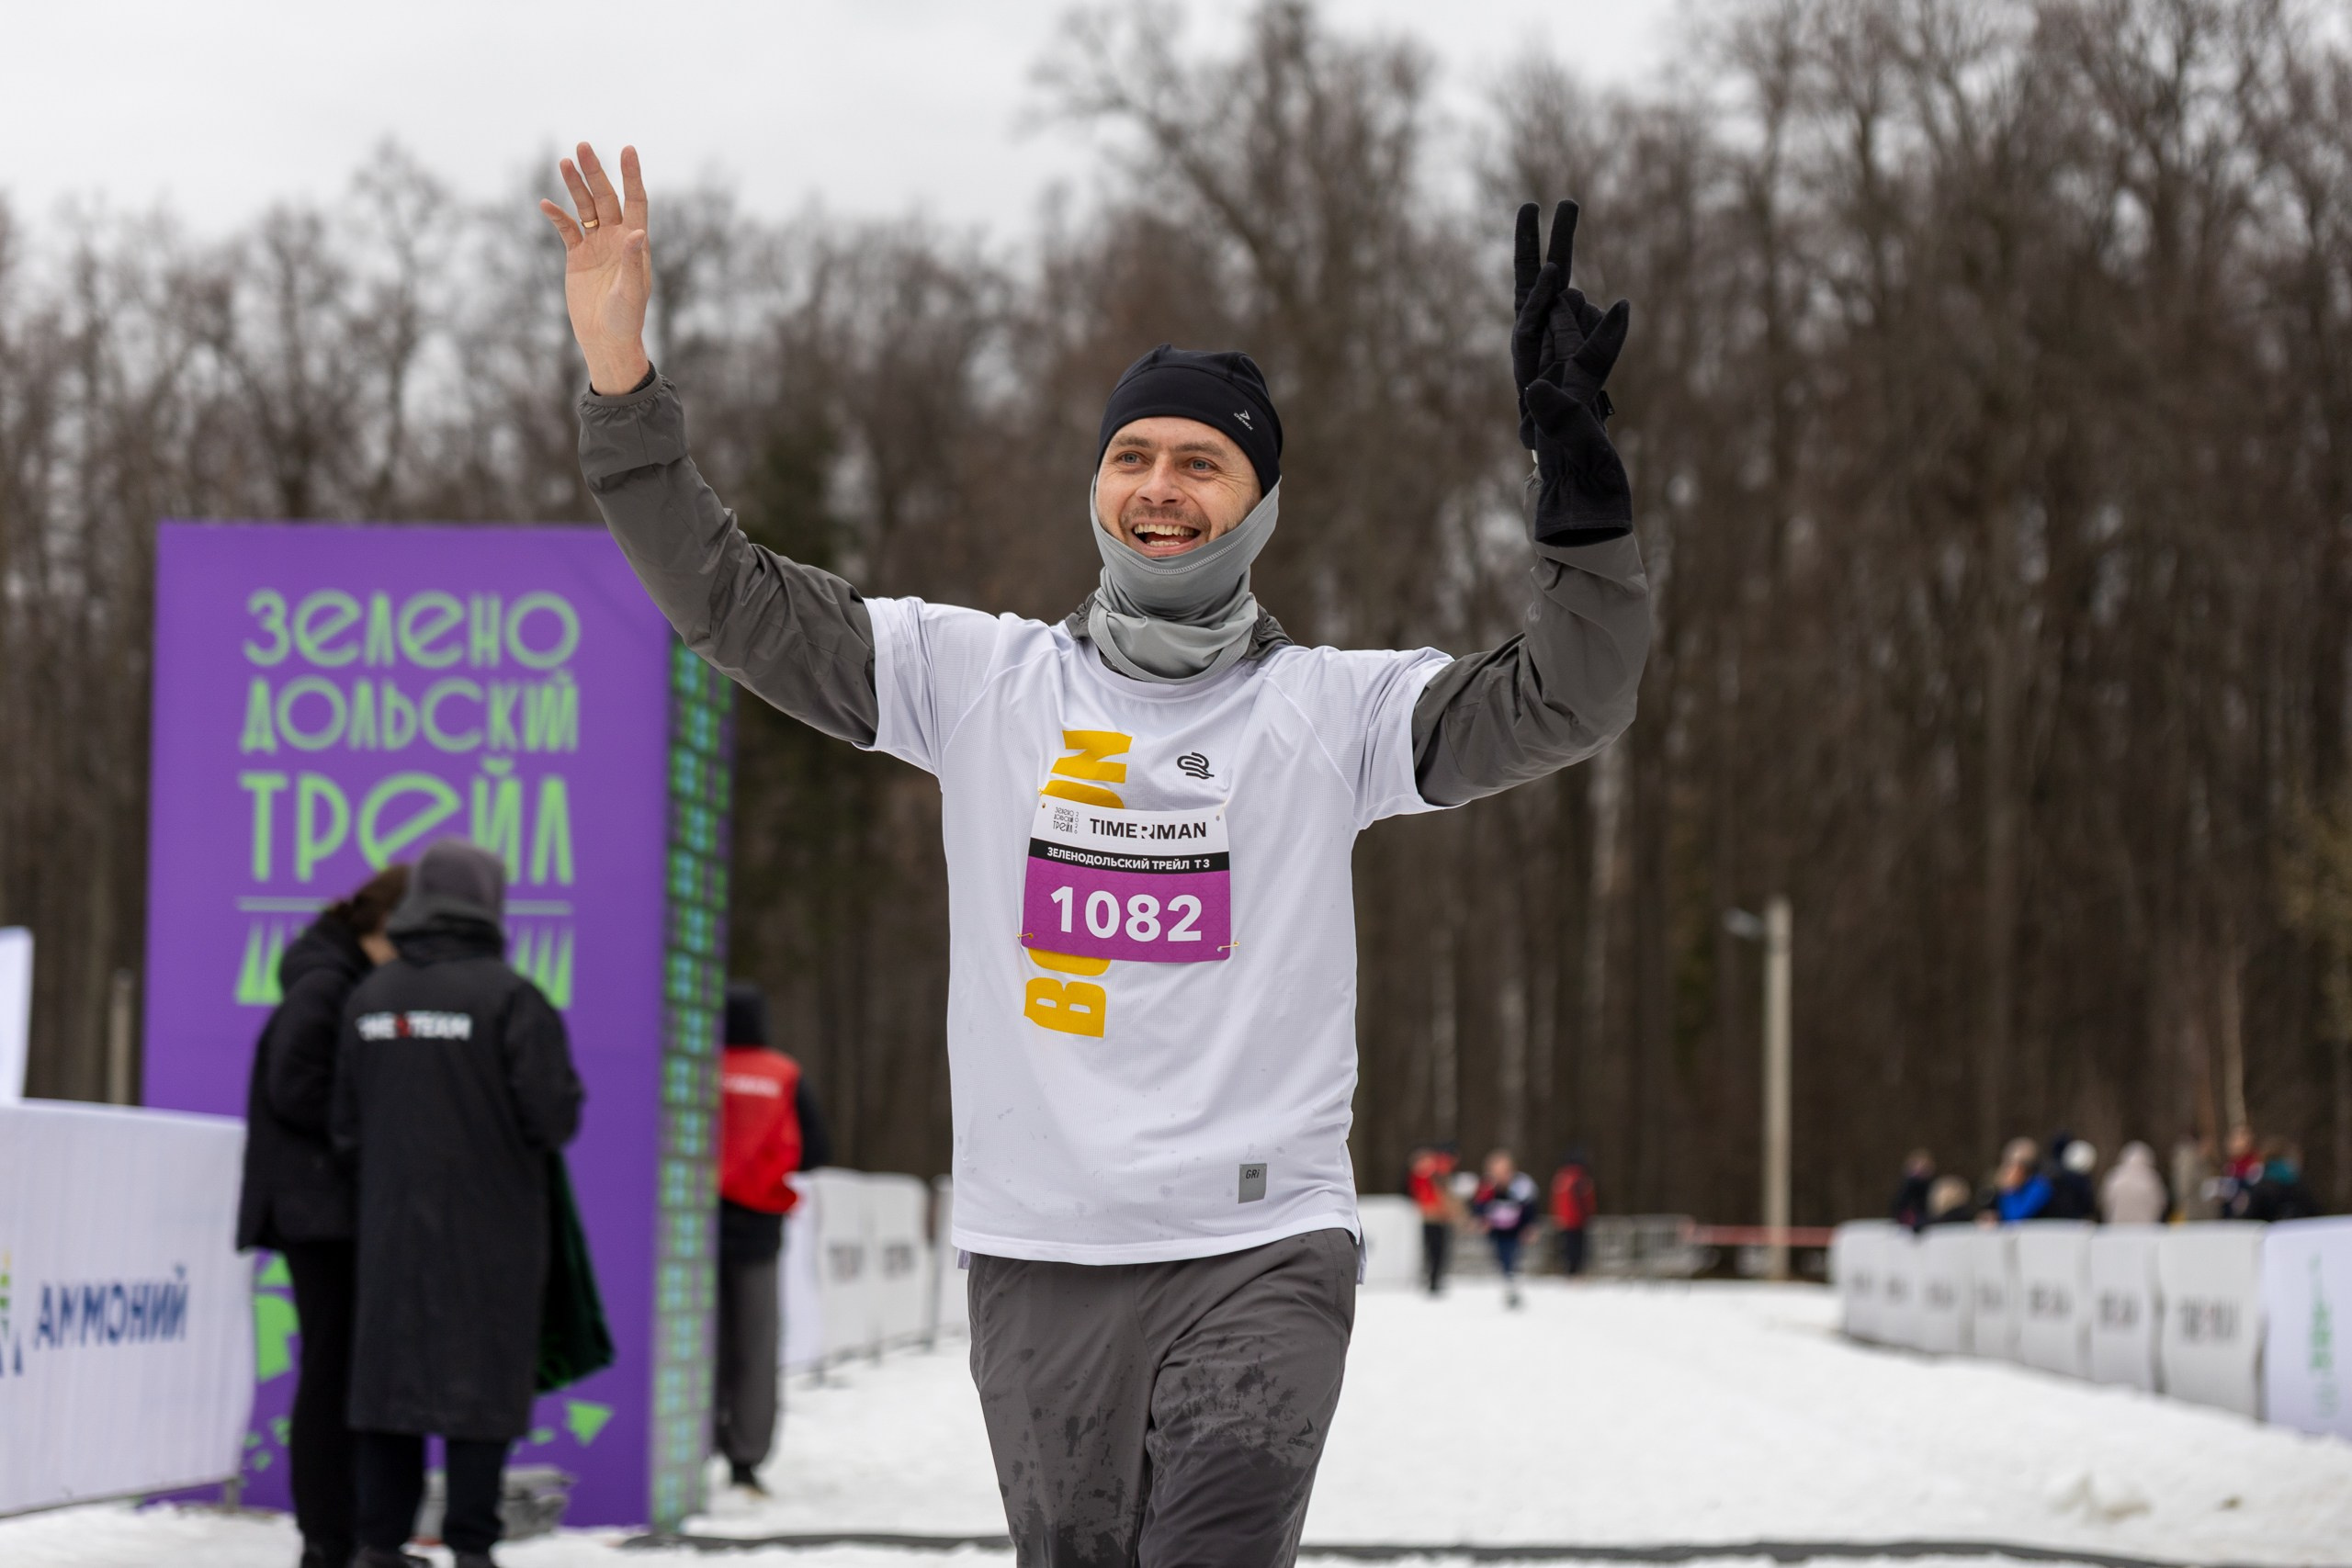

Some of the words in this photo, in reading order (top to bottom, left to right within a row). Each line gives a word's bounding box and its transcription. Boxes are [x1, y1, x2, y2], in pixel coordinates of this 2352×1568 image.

[1046, 847, 1149, 870] ЗЕЛЕНОДОЛЬСКИЙ
[1152, 860, 1190, 870] ТРЕЙЛ
[1050, 886, 1203, 942] 1082
[33, 1262, 189, 1350] АММОНИЙ
